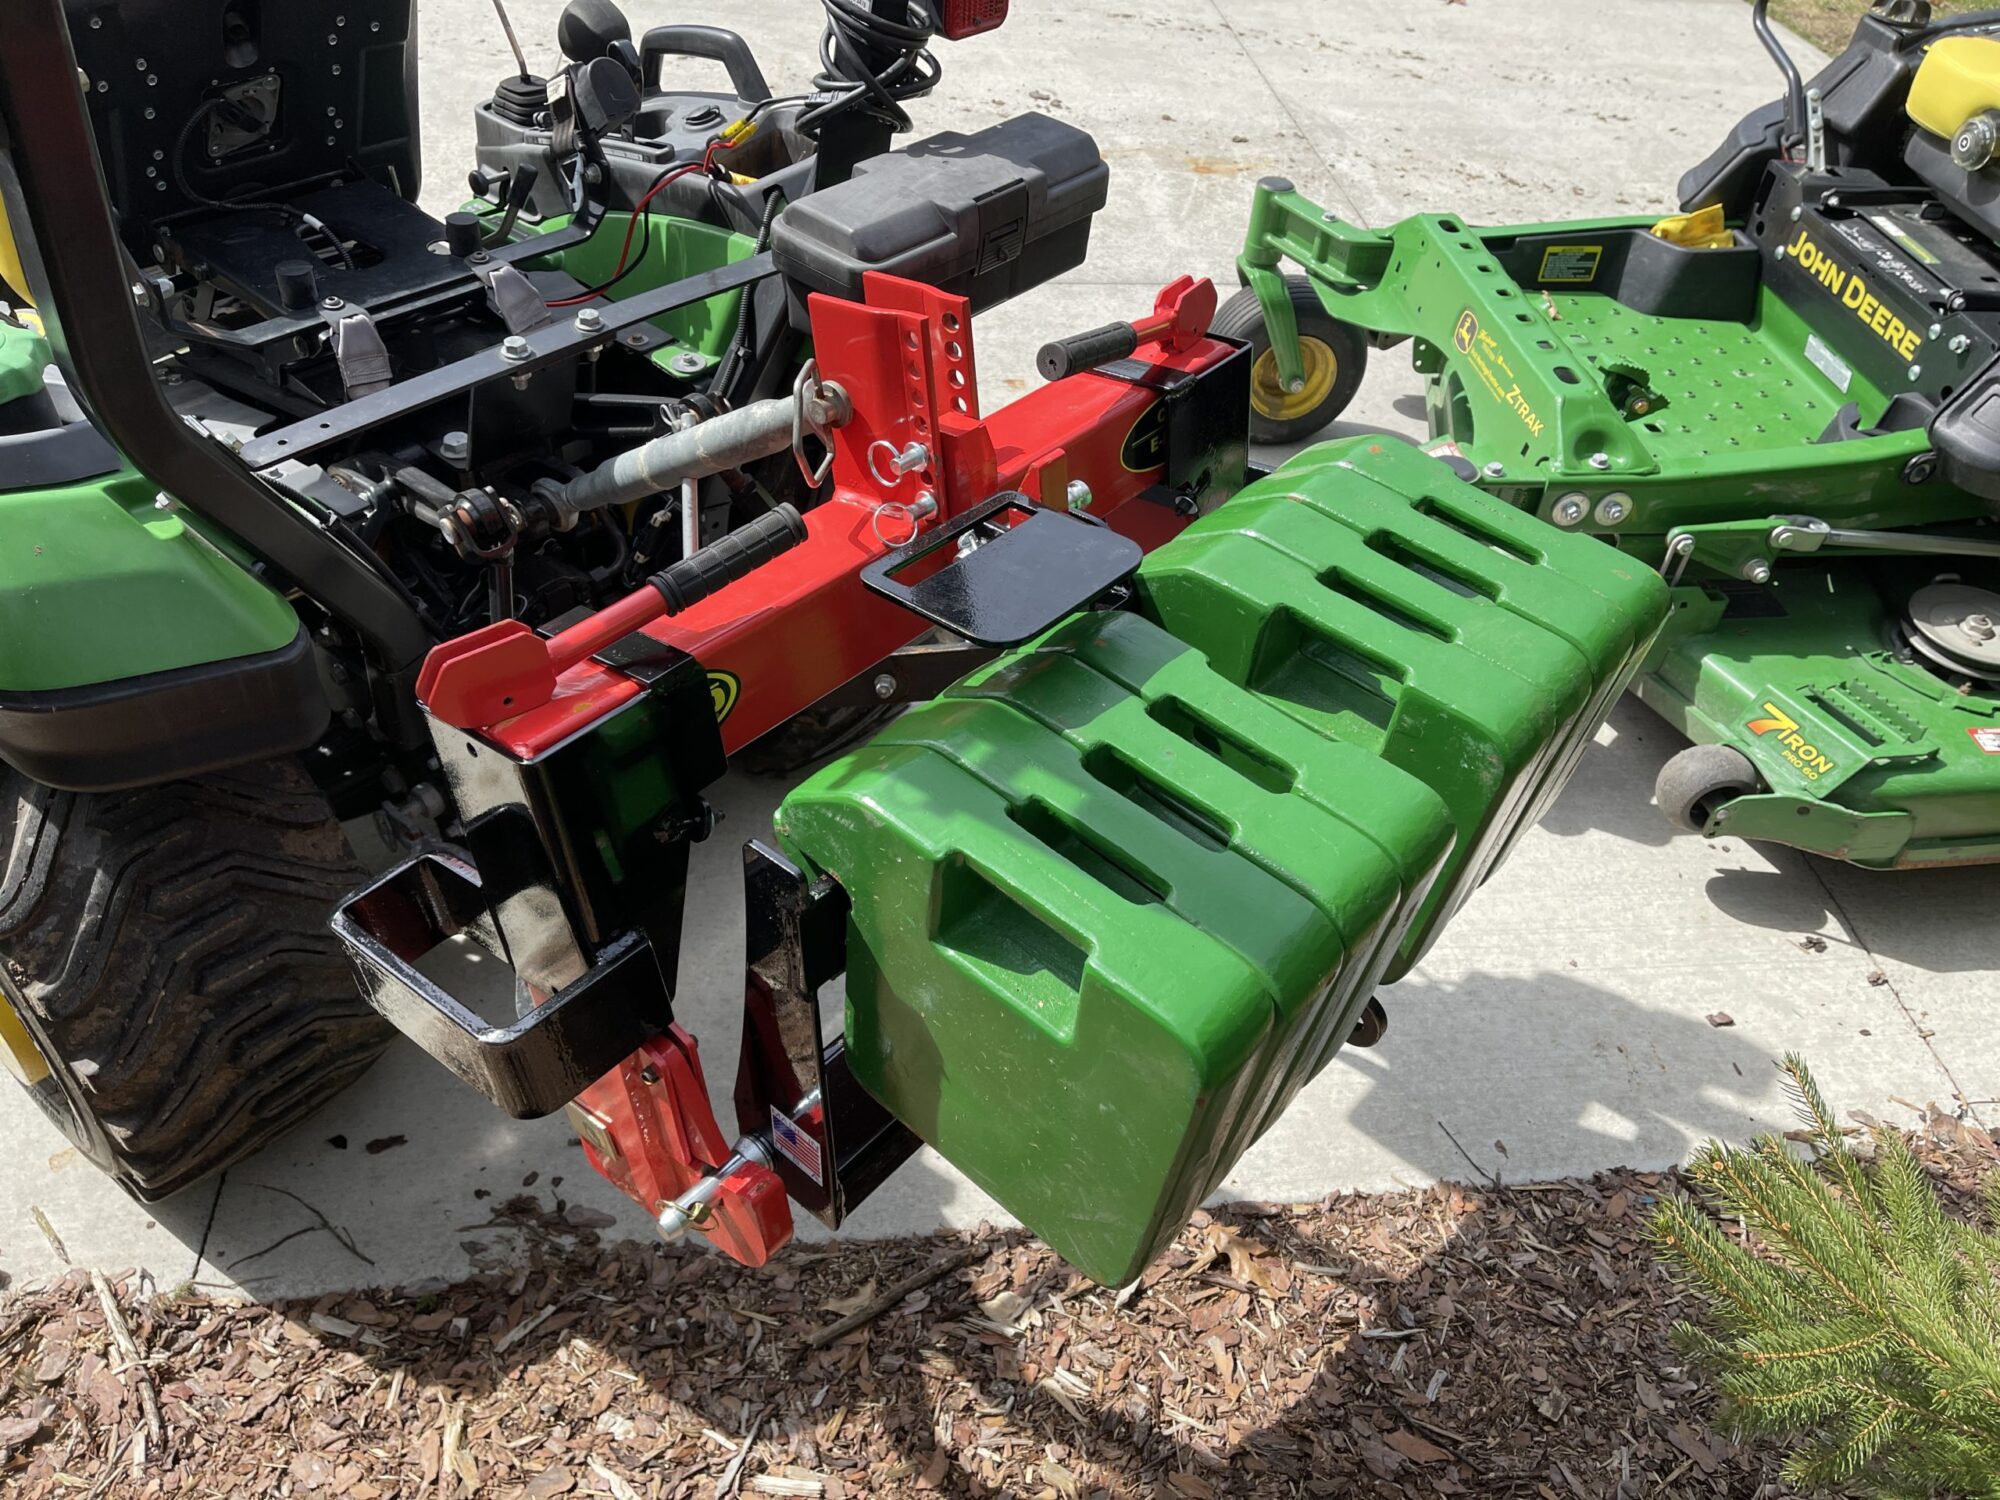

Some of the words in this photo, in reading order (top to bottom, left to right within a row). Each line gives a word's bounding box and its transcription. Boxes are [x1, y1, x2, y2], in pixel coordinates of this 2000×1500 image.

[1786, 231, 1846, 295] JOHN
[1841, 274, 1922, 362] DEERE
[1505, 383, 1545, 437] ZTRAK
[1781, 750, 1803, 768] PRO
[1802, 767, 1818, 780] 60
